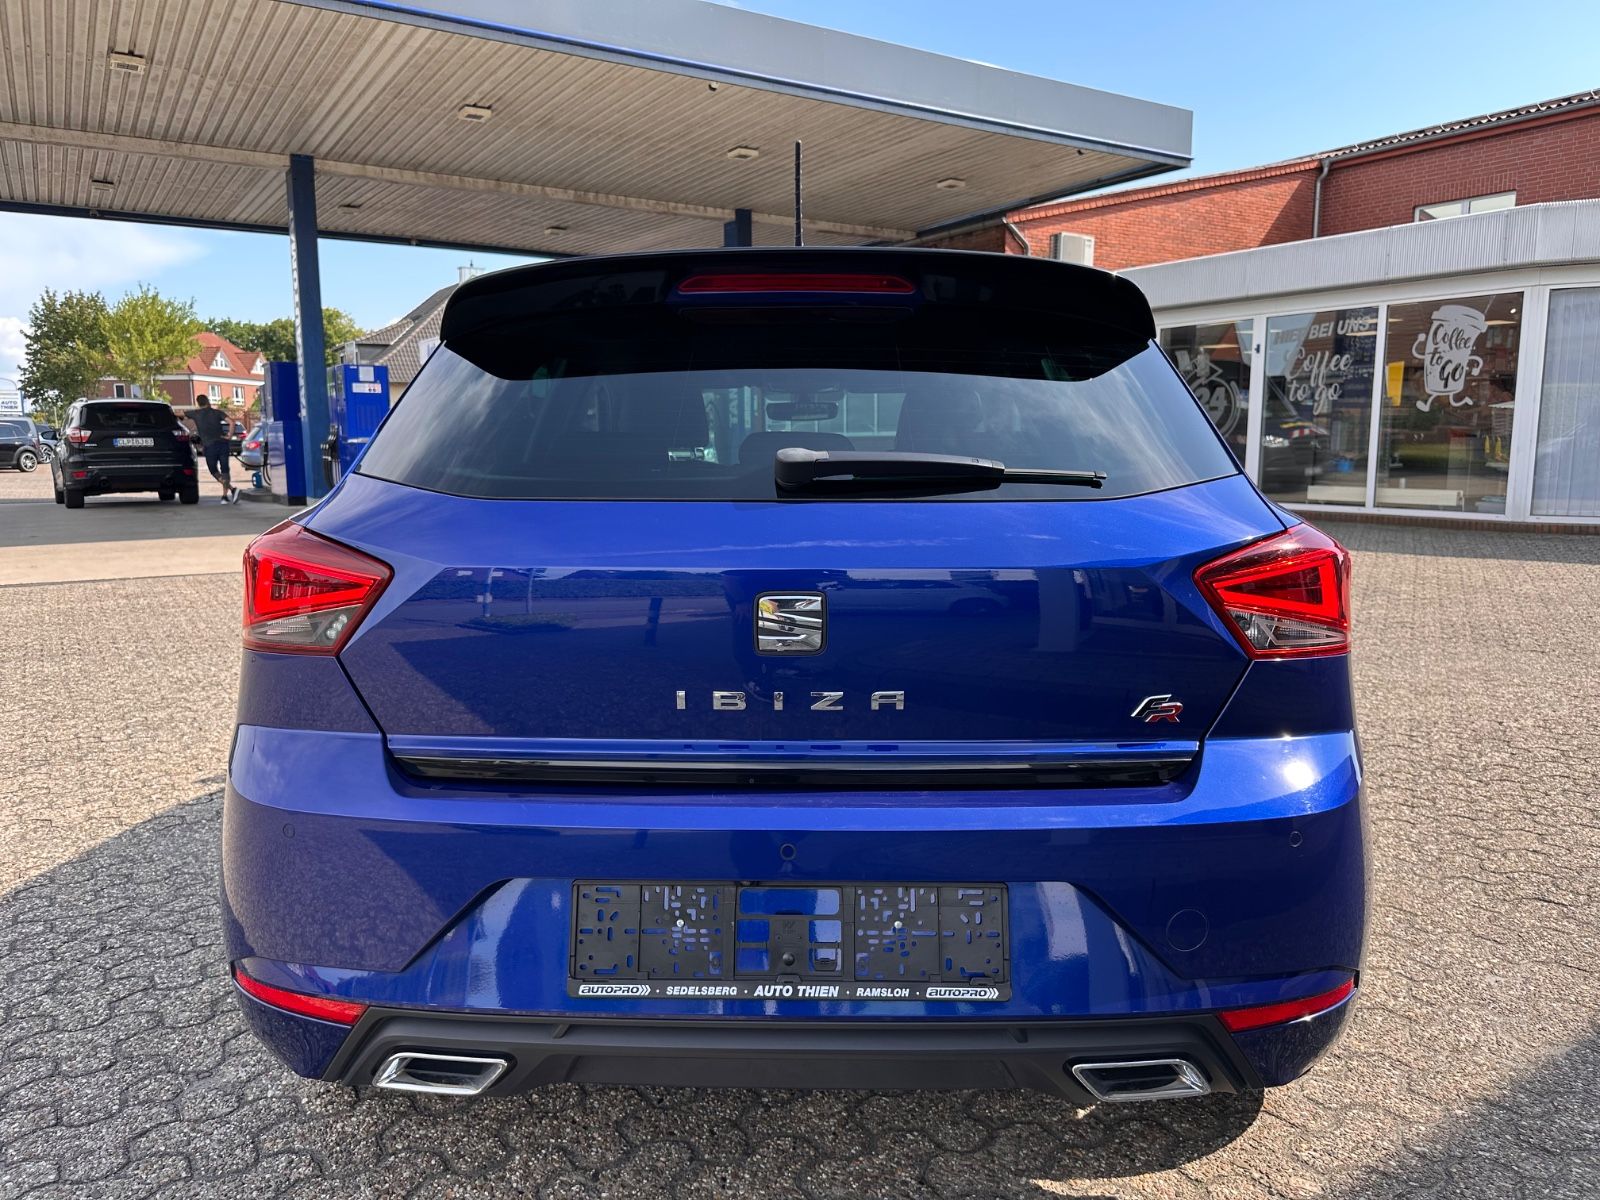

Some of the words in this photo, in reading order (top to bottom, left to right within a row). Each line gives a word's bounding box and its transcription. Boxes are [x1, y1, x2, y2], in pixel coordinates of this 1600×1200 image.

[1308, 321, 1335, 340] BEI
[1337, 316, 1371, 335] UNS
[1432, 323, 1471, 351] Coffee
[1286, 346, 1352, 387] Coffee
[1427, 348, 1443, 366] to
[1288, 380, 1311, 402] to
[1313, 383, 1342, 415] go
[676, 690, 905, 711] IBIZA
[1130, 694, 1183, 722] FR
[666, 985, 737, 996] SEDELSBERG
[754, 985, 793, 997] AUTO
[797, 985, 839, 997] THIEN
[856, 987, 909, 997] RAMSLOH
